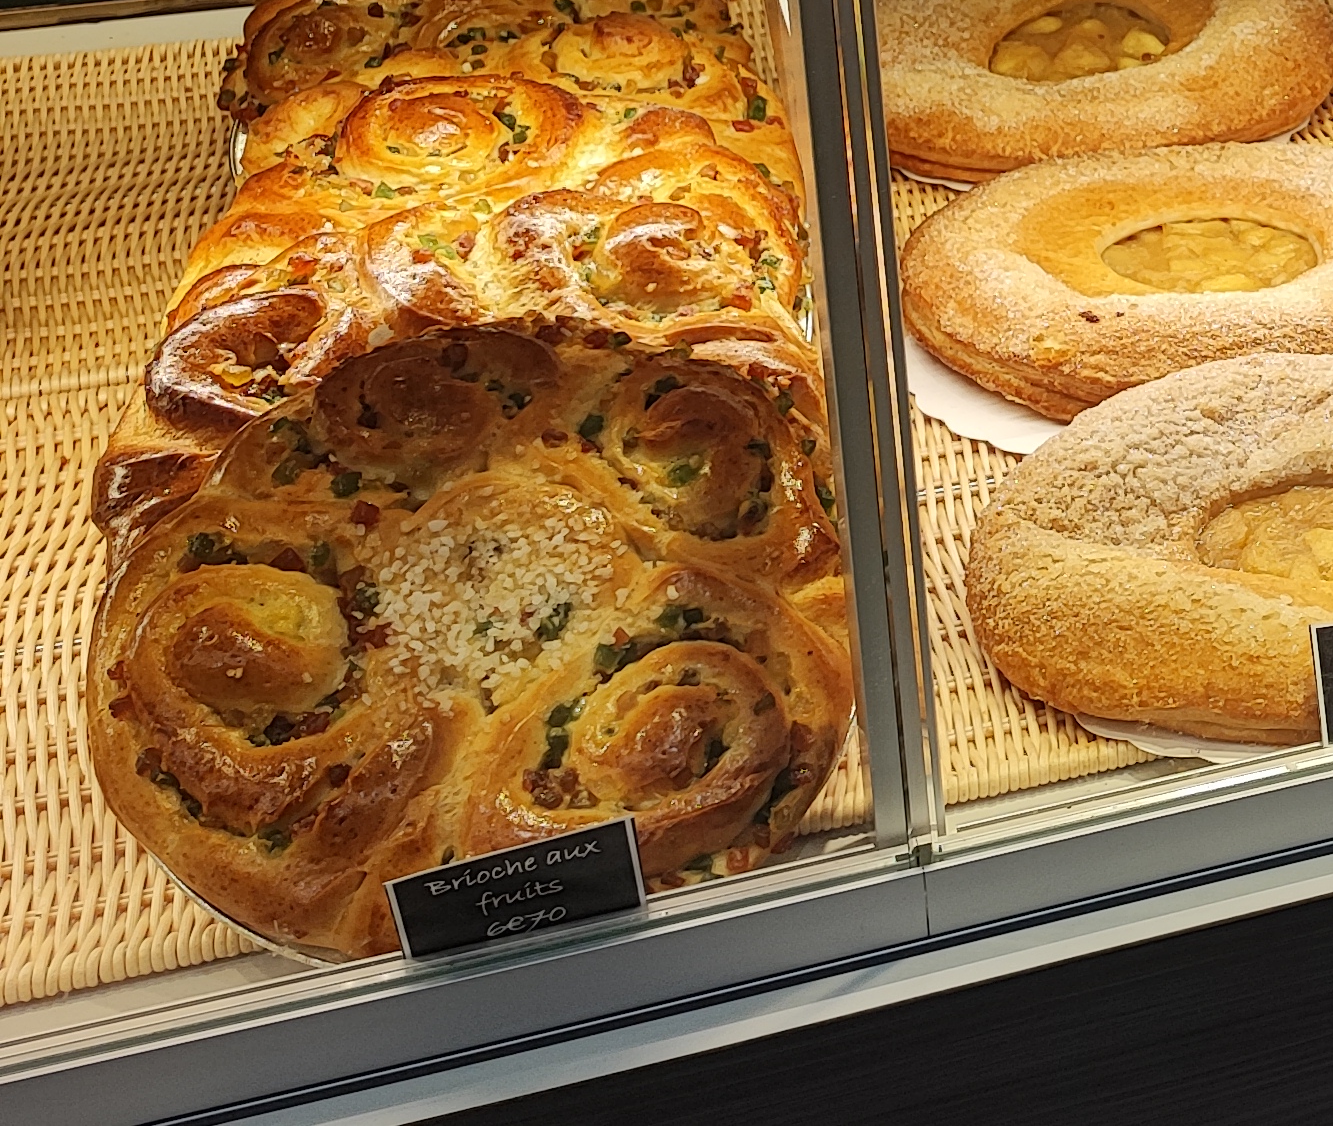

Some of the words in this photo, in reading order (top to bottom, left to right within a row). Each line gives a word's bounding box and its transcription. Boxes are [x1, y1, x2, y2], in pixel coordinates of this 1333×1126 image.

[424, 856, 538, 897] Brioche
[546, 839, 602, 864] aux
[475, 879, 564, 916] fruits
